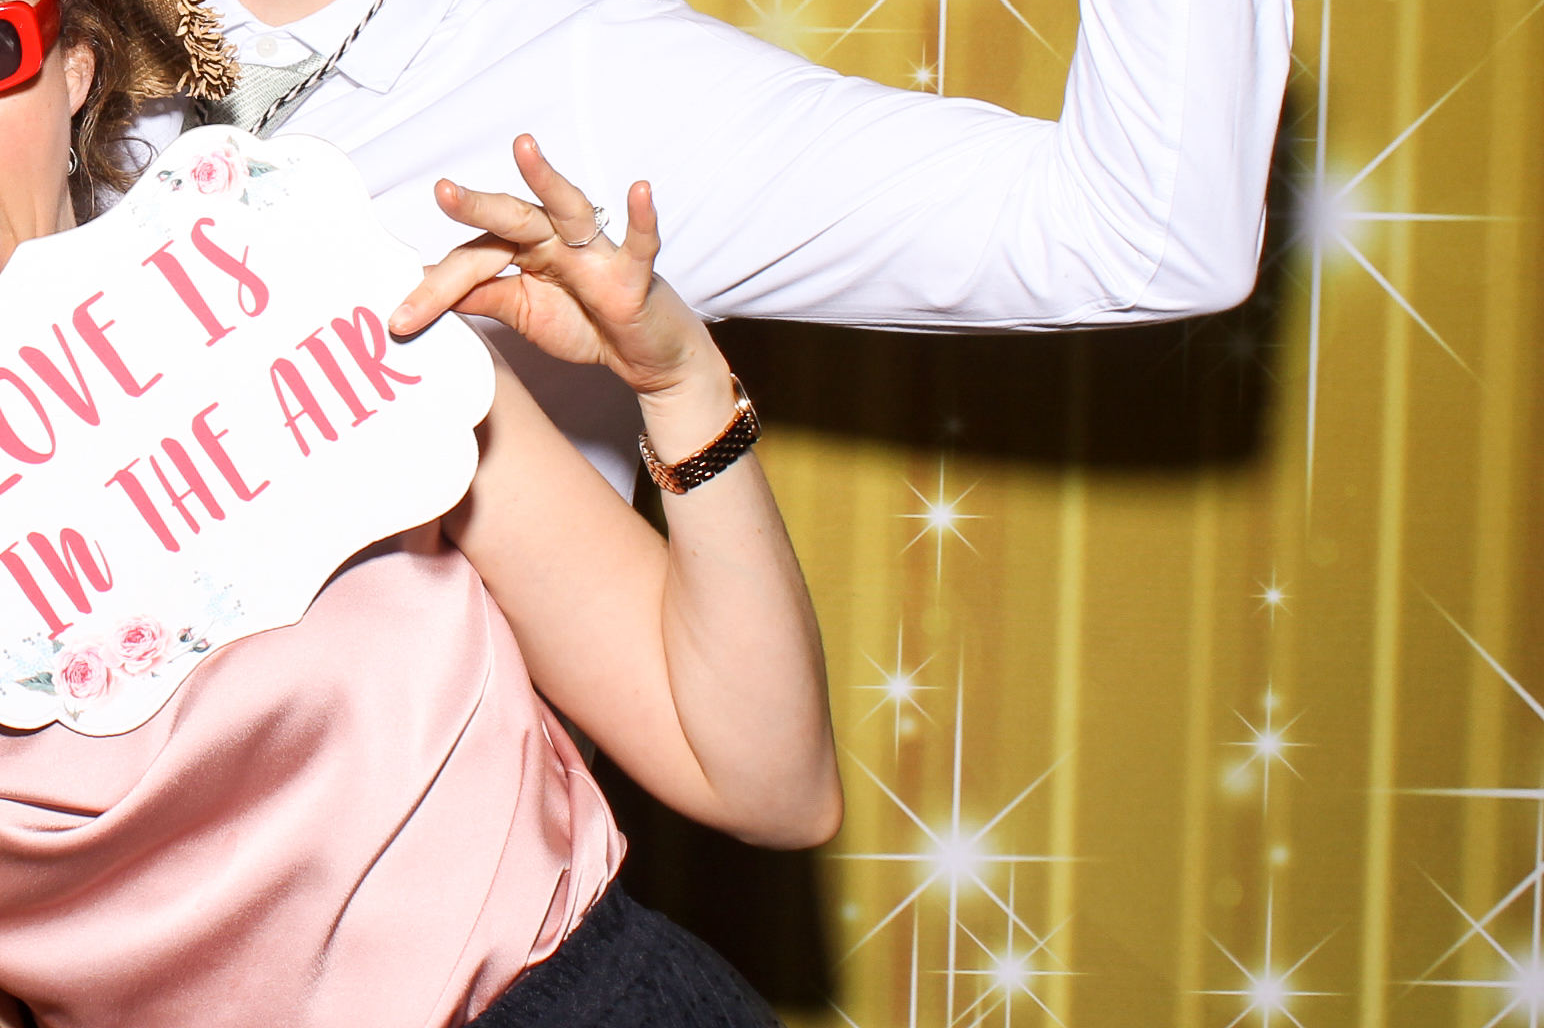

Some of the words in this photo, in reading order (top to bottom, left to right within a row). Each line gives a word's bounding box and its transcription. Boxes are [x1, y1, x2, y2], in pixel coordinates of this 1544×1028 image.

[141, 217, 270, 347] IS
[104, 402, 271, 553] THE
[269, 305, 423, 457] AIR
